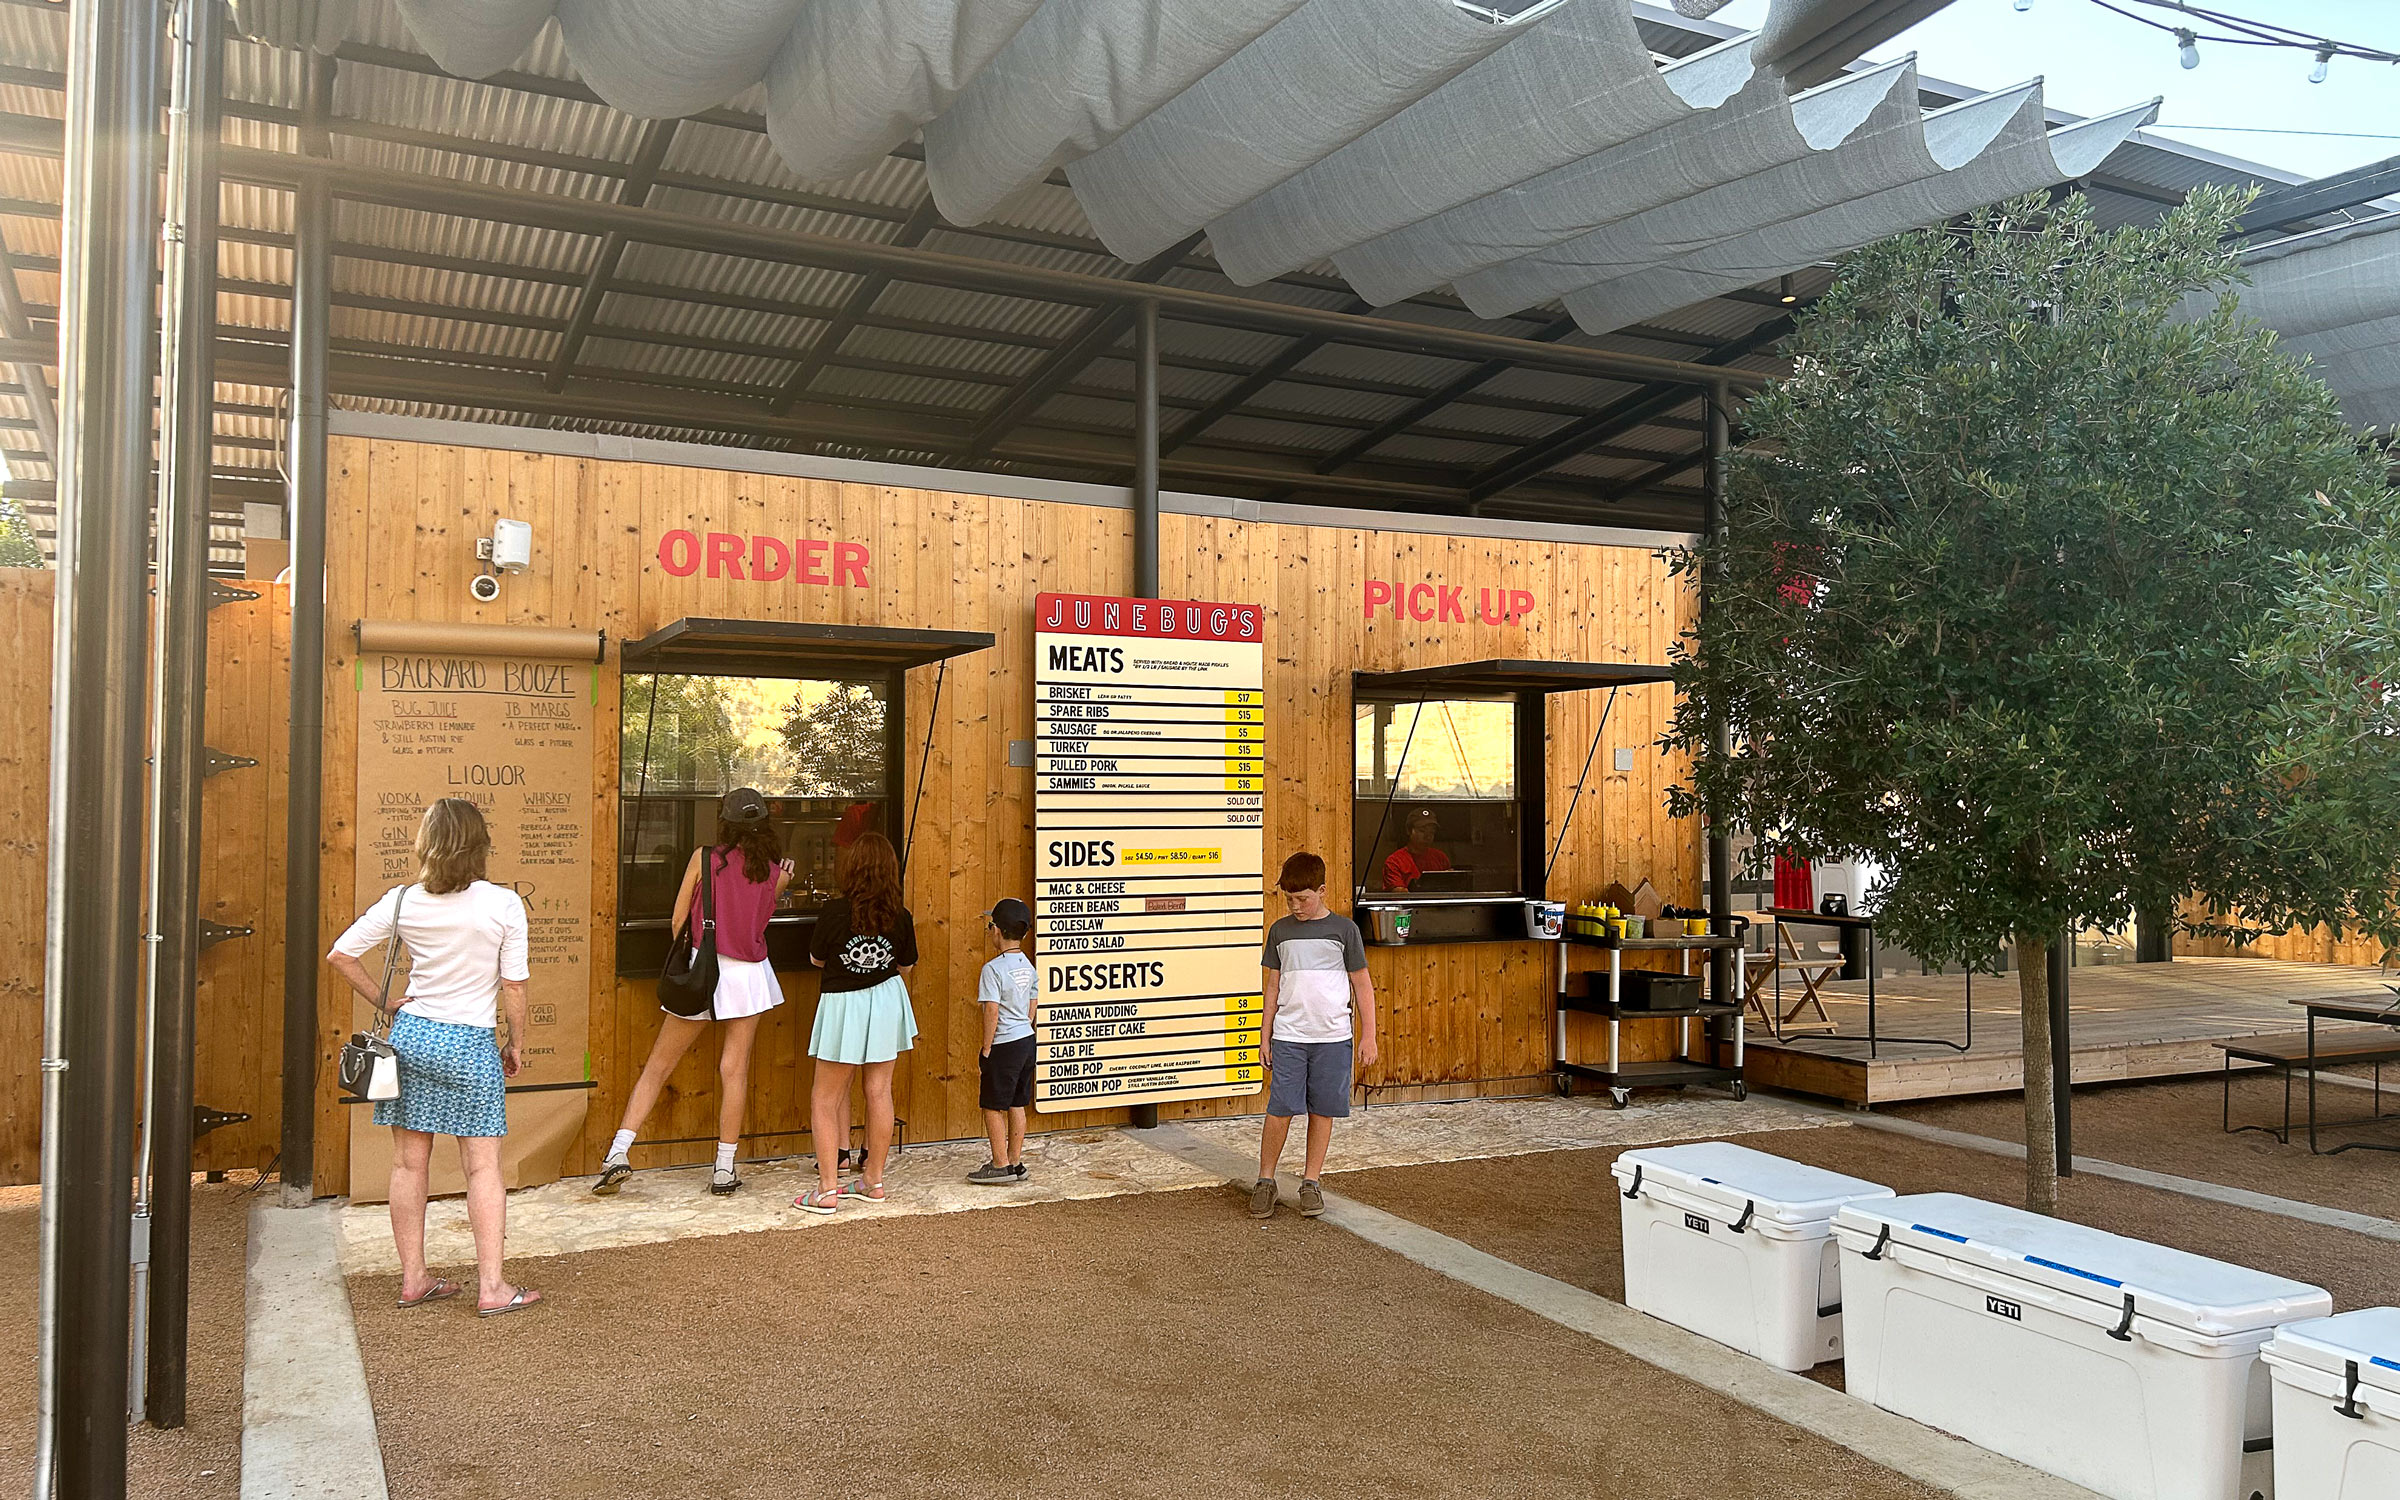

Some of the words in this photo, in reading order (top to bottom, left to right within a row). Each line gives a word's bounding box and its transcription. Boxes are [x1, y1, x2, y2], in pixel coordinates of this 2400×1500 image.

[658, 529, 870, 588] ORDER
[1364, 580, 1466, 623] PICK
[1480, 587, 1535, 626] UP
[1046, 599, 1254, 637] JUNEBUG'S
[1049, 645, 1125, 674] MEATS
[382, 656, 486, 690] BACKYARD
[503, 661, 576, 694] BOOZE
[1049, 687, 1091, 700] BRISKET
[1237, 693, 1250, 703] $17
[392, 700, 421, 715] BUG
[428, 701, 457, 717] JUICE
[504, 701, 521, 716] JB
[530, 702, 571, 718] MARGS
[1049, 705, 1083, 718] SPARE
[1086, 706, 1110, 718] RIBS
[1238, 710, 1251, 720] $15
[373, 720, 434, 731] STRAWBERRY
[439, 722, 476, 731] LEMONADE
[518, 721, 551, 731] PERFECT
[1049, 723, 1097, 736] SAUSAGE
[392, 734, 414, 743] STILL
[419, 735, 446, 743] AUSTIN
[1238, 728, 1248, 737] $5
[426, 747, 454, 755] PITCHER
[1049, 741, 1089, 753] TURKEY
[1238, 745, 1251, 755] $15
[1050, 759, 1087, 771] PULLED
[1090, 760, 1118, 772] PORK
[1238, 762, 1251, 772] $15
[447, 764, 526, 786] LIQUOR
[1049, 777, 1096, 790] SAMMIES
[1237, 779, 1250, 789] $16
[377, 792, 421, 805] VODKA
[449, 791, 496, 805] TEQUILA
[523, 792, 571, 805] WHISKEY
[1227, 797, 1244, 806] SOLD
[1246, 797, 1260, 806] OUT
[1227, 814, 1244, 823] SOLD
[1246, 814, 1260, 823] OUT
[382, 826, 408, 839] GIN
[1048, 840, 1115, 867] SIDES
[1136, 852, 1153, 861] $4.50
[1170, 852, 1188, 860] $8.50
[1208, 851, 1219, 859] $16
[384, 857, 408, 869] RUM
[1049, 883, 1072, 896] MAC
[1075, 883, 1085, 895] &
[1087, 882, 1125, 894] CHEESE
[1049, 901, 1084, 913] GREEN
[1086, 900, 1120, 912] BEANS
[1049, 919, 1104, 932] COLESLAW
[1049, 937, 1090, 950] POTATO
[1092, 936, 1125, 949] SALAD
[1048, 961, 1164, 993] DESSERTS
[531, 1006, 552, 1014] COLD
[1237, 999, 1248, 1008] $8
[533, 1015, 554, 1023] CANS
[1049, 1008, 1091, 1021] BANANA
[1094, 1005, 1138, 1018] PUDDING
[1237, 1016, 1248, 1026] $7
[1049, 1027, 1083, 1040] TEXAS
[1085, 1024, 1117, 1038] SHEET
[1118, 1022, 1146, 1035] CAKE
[1237, 1034, 1248, 1044] $7
[529, 1047, 556, 1055] CHERRY
[1049, 1045, 1075, 1058] SLAB
[1078, 1044, 1095, 1056] PIE
[1237, 1051, 1248, 1061] $5
[1049, 1064, 1080, 1077] BOMB
[1082, 1062, 1103, 1075] POP
[1237, 1069, 1250, 1080] $12
[1049, 1081, 1099, 1096] BOURBON
[1101, 1079, 1122, 1092] POP
[1686, 1215, 1708, 1231] YETI
[1988, 1298, 2019, 1318] YETI
